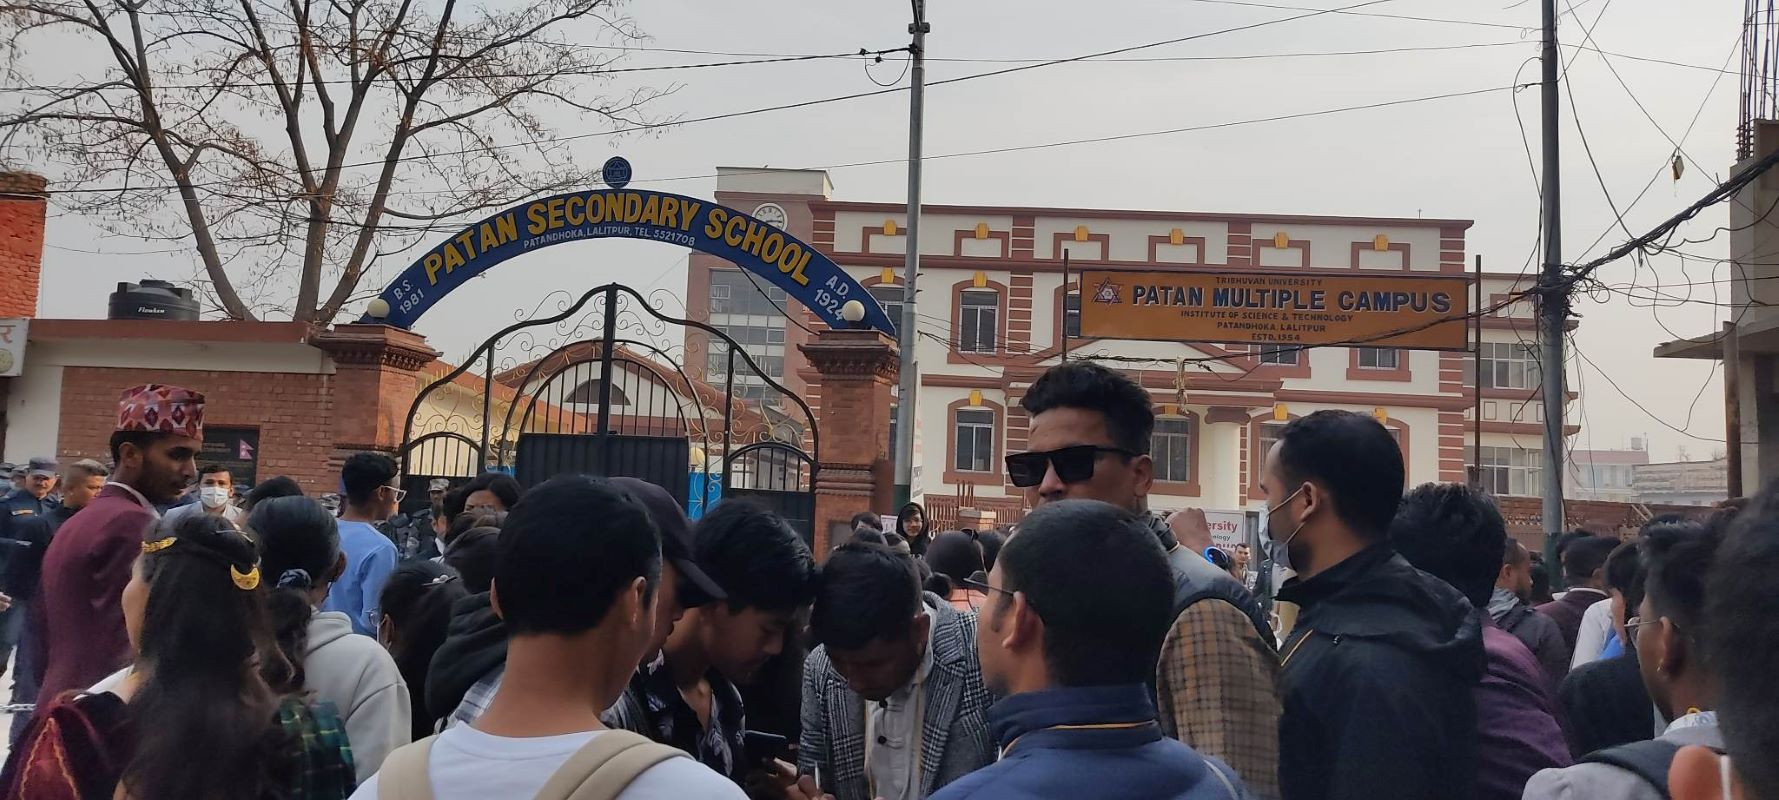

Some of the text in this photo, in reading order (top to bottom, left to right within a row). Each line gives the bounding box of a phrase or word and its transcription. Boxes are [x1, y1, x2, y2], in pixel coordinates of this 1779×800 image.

[423, 192, 813, 287] PATAN SECONDARY SCHOOL
[653, 229, 696, 246] 5521708
[393, 279, 414, 300] B.S.
[825, 274, 849, 300] A.D.
[1215, 276, 1323, 287] TRIBHUVAN UNIVERSITY
[399, 287, 425, 315] 1981
[814, 289, 844, 321] 1924
[1132, 285, 1452, 315] PATAN MULTIPLE CAMPUS
[1180, 310, 1354, 323] INSTITUTE OF SCIENCE & TECHNOLOGY
[1280, 323, 1326, 333] LALITPUR
[1207, 520, 1238, 534] ersity
